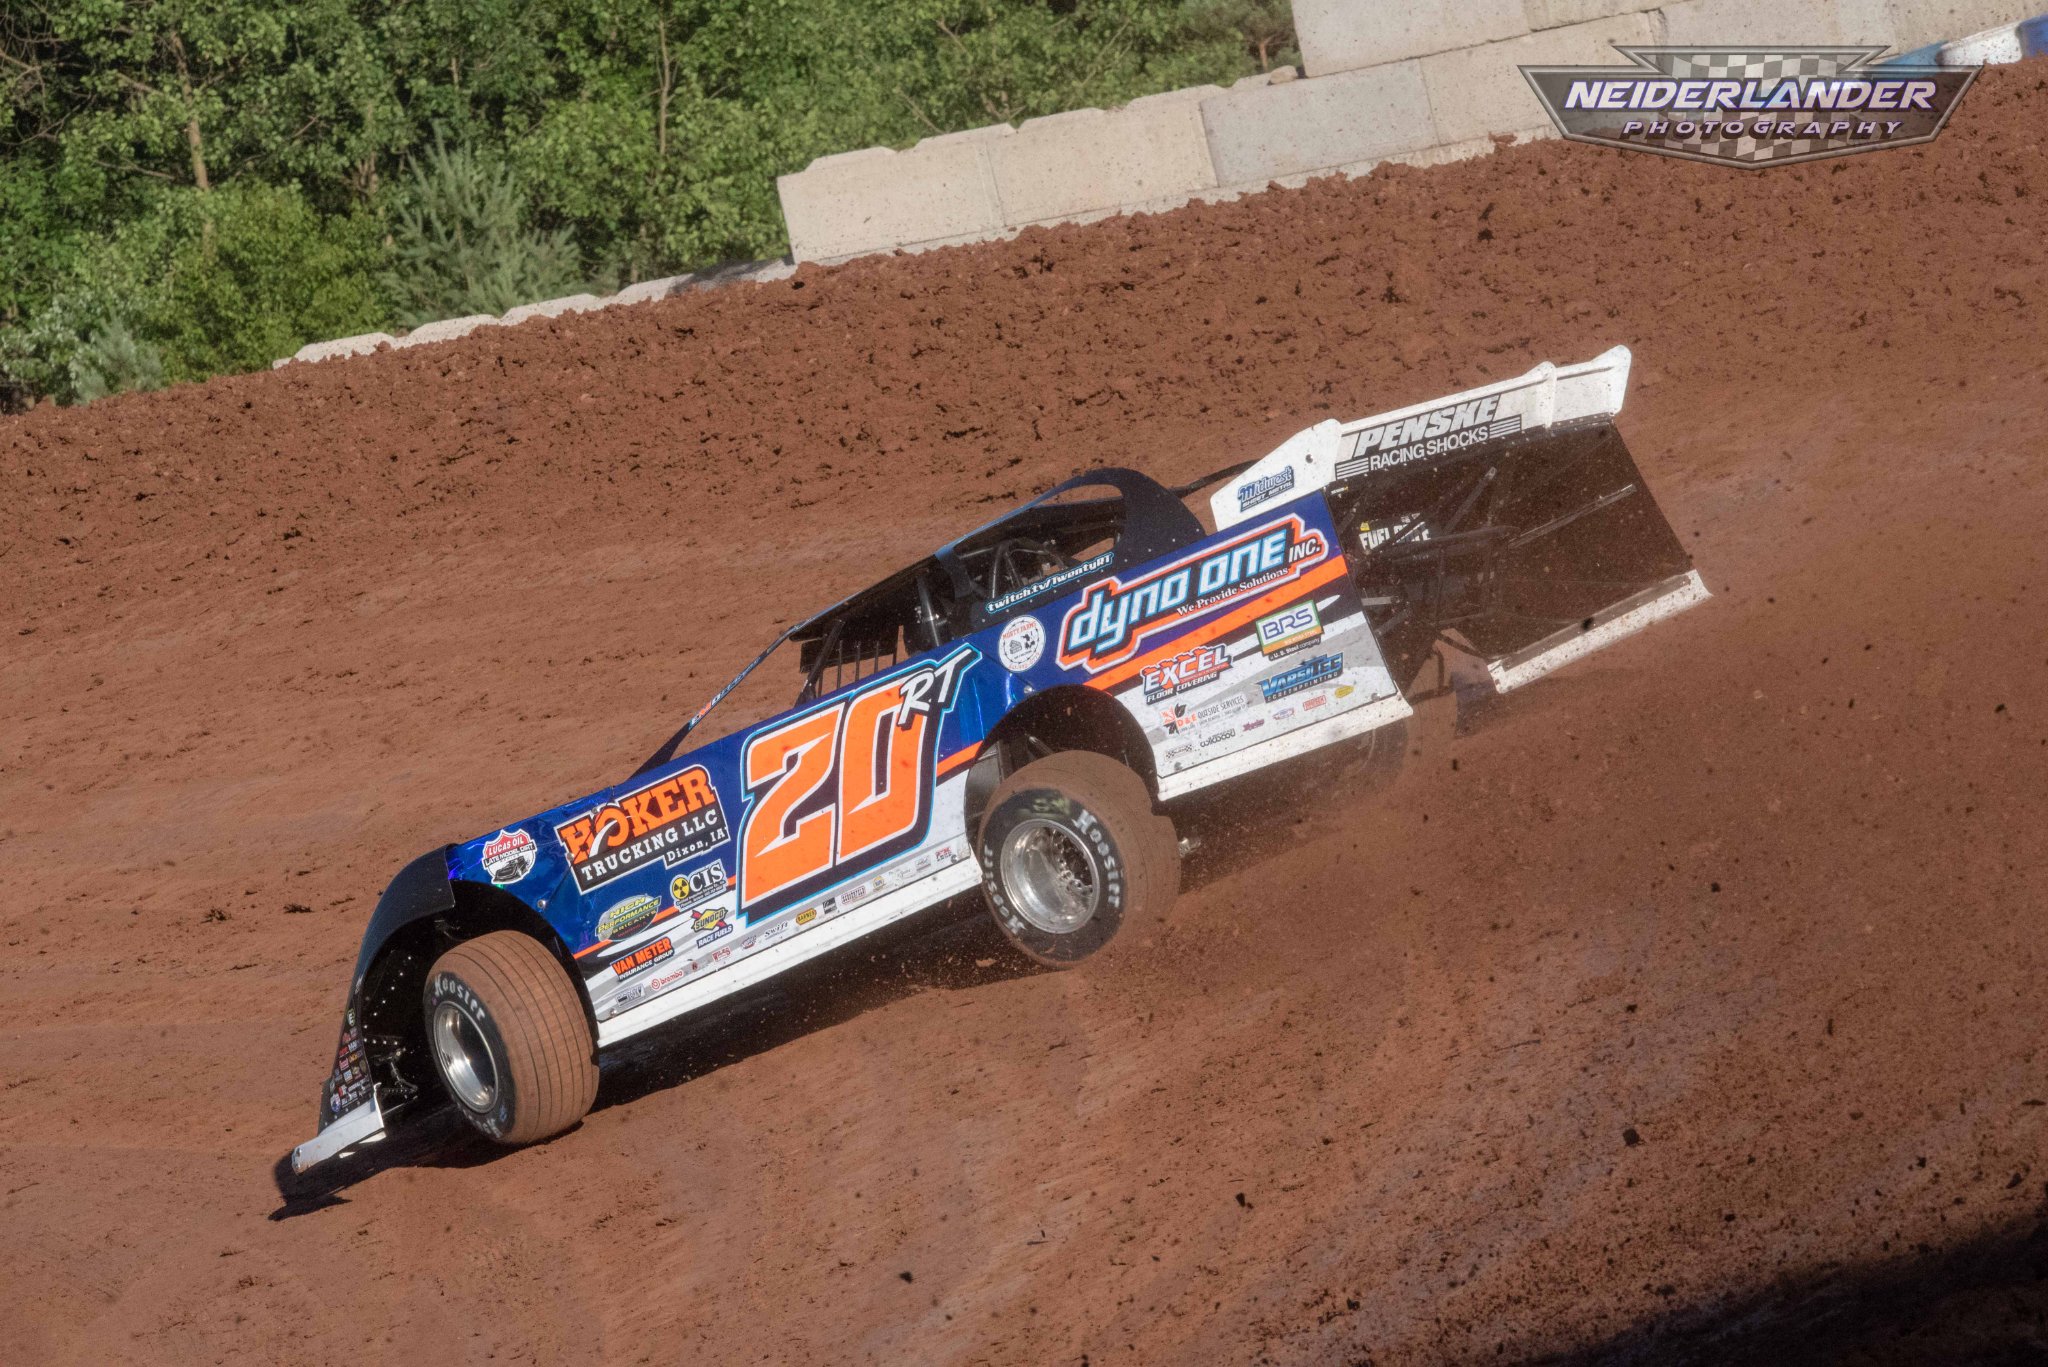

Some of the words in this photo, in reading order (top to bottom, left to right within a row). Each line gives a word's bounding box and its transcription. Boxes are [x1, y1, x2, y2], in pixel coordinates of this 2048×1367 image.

[1353, 394, 1500, 457] PENSKE
[1370, 444, 1425, 470] RACING
[1426, 426, 1489, 455] SHOCKS
[1238, 466, 1293, 501] Midwest
[1068, 568, 1191, 653] dyno
[1289, 538, 1321, 563] INC.
[1177, 604, 1195, 616] We
[1196, 587, 1237, 608] Provide
[1240, 567, 1289, 592] Solutions
[1262, 608, 1313, 640] BRS
[1300, 638, 1320, 649] company
[1146, 647, 1228, 692] EXCEL
[1147, 688, 1173, 702] FLOOR
[1176, 672, 1217, 691] COVERING
[1221, 695, 1245, 710] SERVICES
[742, 677, 927, 908] 20
[898, 649, 972, 725] RT
[561, 768, 716, 864] HOKER
[488, 841, 511, 856] LUCAS
[512, 836, 524, 847] OIL
[519, 843, 534, 852] DIRT
[581, 827, 683, 881] TRUCKING
[682, 809, 718, 836] LLC
[667, 837, 708, 861] Dixon,
[711, 829, 725, 843] IA
[689, 864, 724, 892] CIS
[598, 899, 659, 933] PERFORMANCE
[609, 897, 646, 918] HIGH
[695, 909, 724, 929] SUNOCO
[698, 933, 713, 946] RACE
[714, 925, 732, 939] FUELS
[612, 956, 635, 975] VAN
[634, 939, 672, 964] METER
[619, 960, 653, 980] INSURANCE
[654, 950, 673, 965] GROUP
[660, 970, 683, 984] brembo
